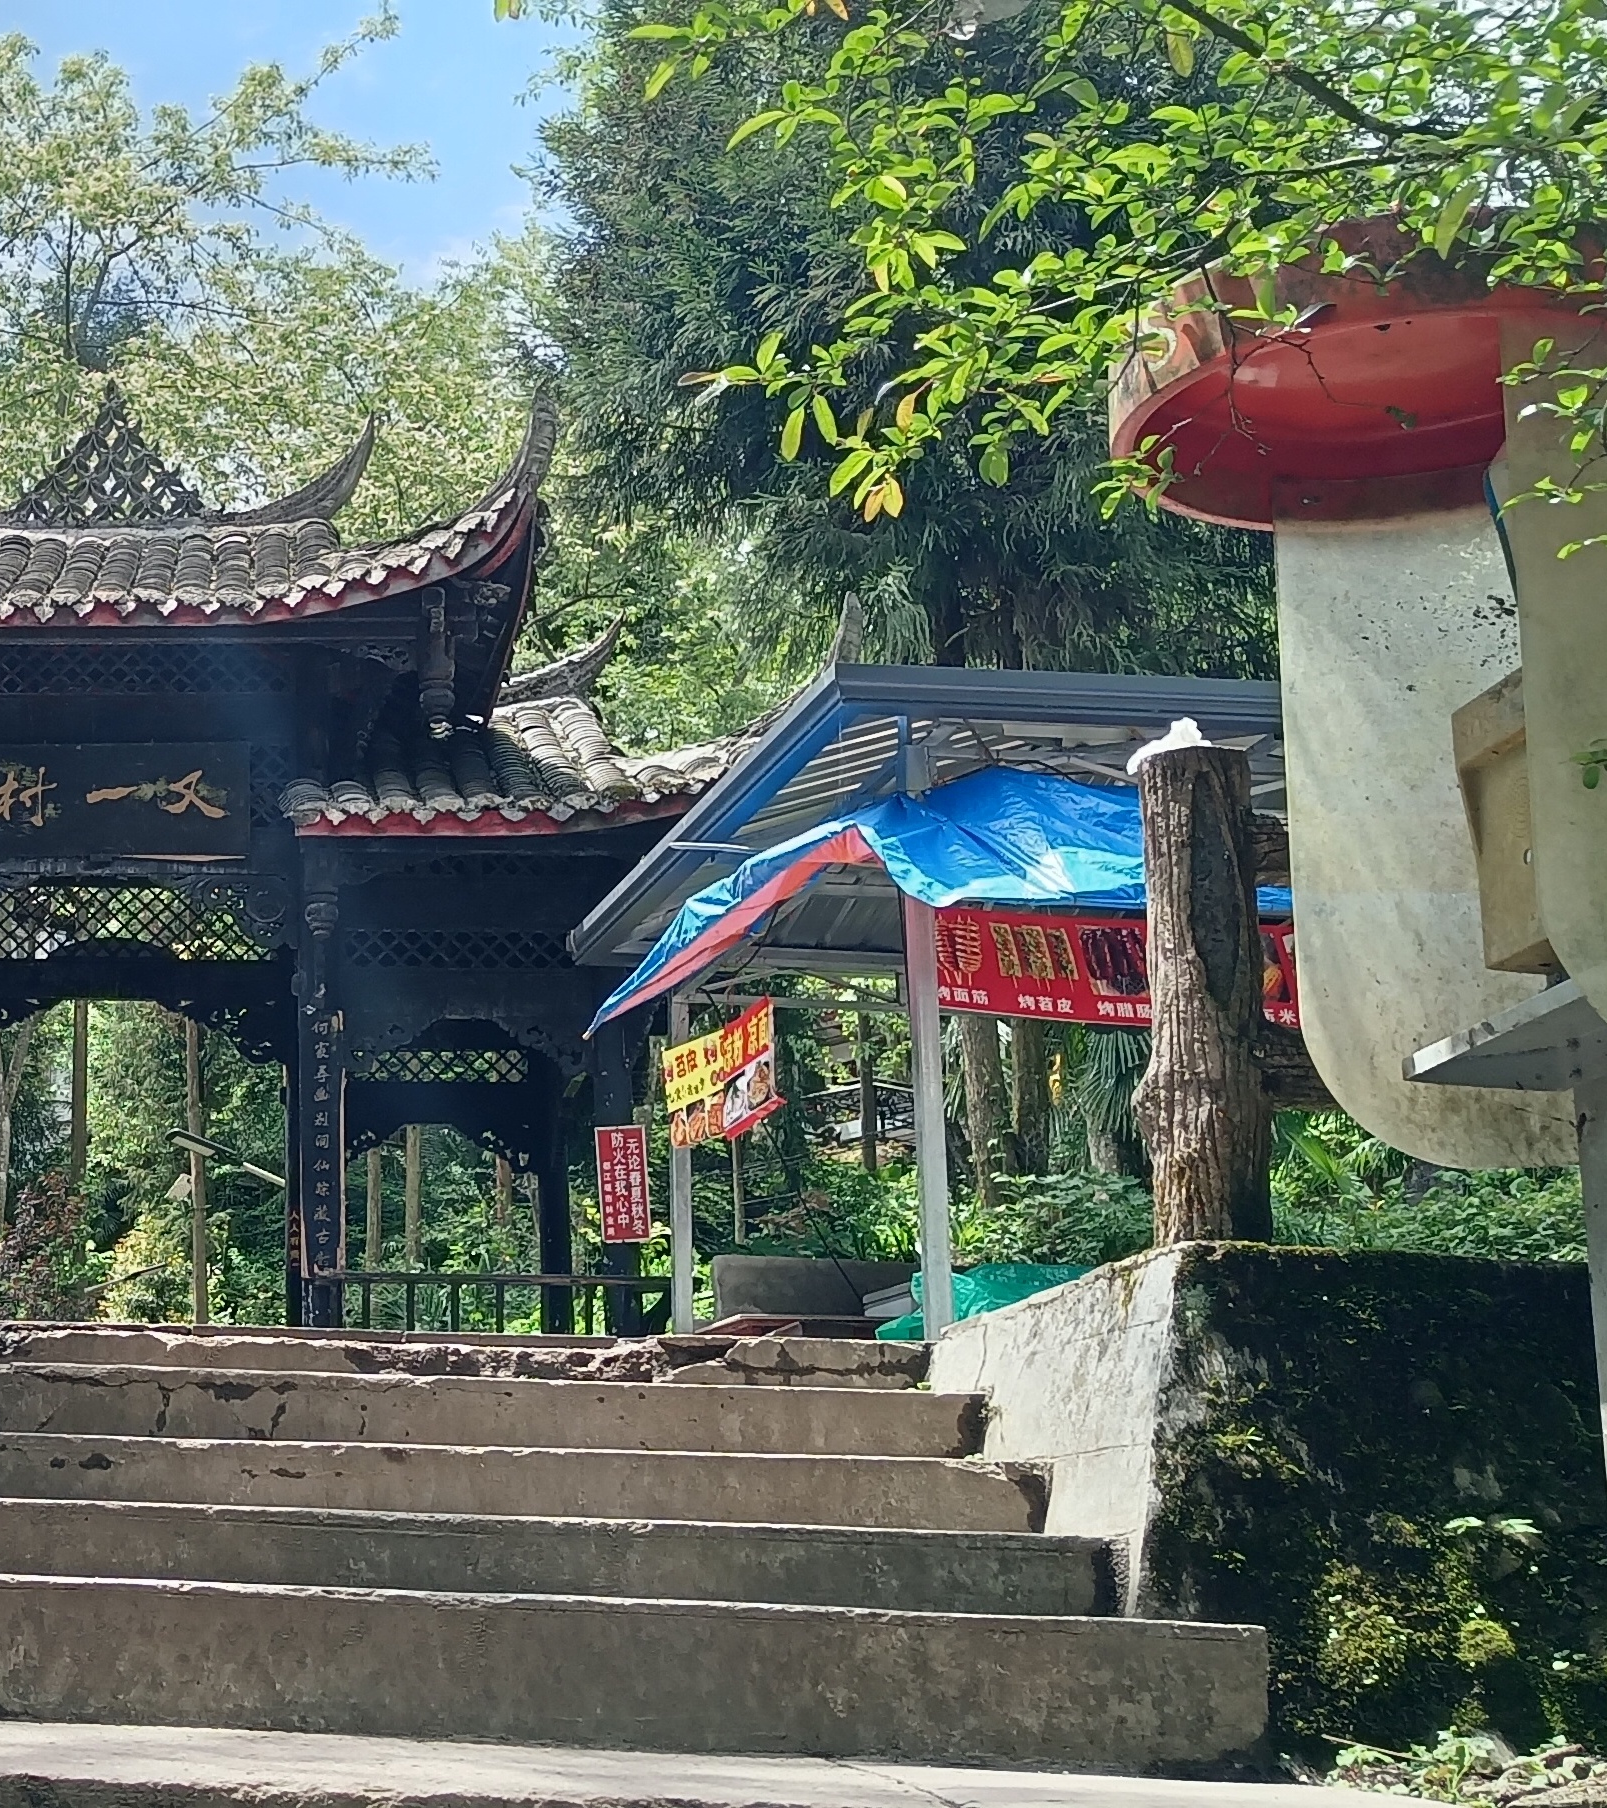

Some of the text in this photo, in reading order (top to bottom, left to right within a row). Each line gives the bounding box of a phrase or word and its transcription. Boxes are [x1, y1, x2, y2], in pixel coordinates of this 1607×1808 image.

[610, 1131, 630, 1229] 防火在我心中
[625, 1138, 646, 1236] 无论春夏秋冬
